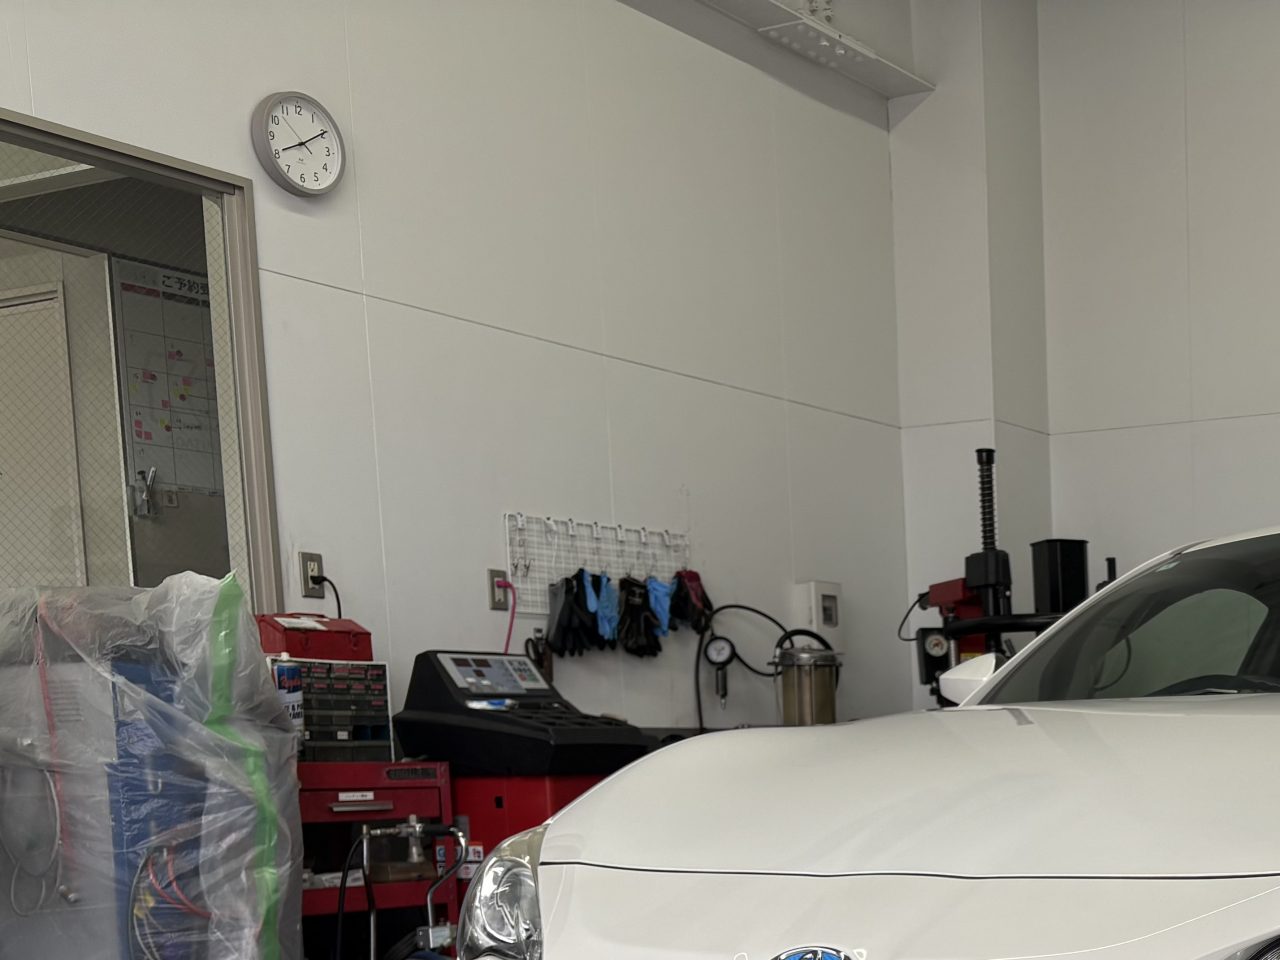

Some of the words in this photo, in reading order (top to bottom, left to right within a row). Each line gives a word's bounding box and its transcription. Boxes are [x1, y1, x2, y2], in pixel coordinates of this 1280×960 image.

[281, 104, 289, 116] 11
[294, 104, 302, 116] 12
[271, 114, 280, 126] 10
[268, 130, 275, 141] 9
[273, 148, 280, 159] 8
[325, 146, 331, 157] 3
[285, 164, 291, 174] 7
[322, 162, 328, 173] 4
[299, 173, 306, 184] 6
[313, 172, 319, 182] 5
